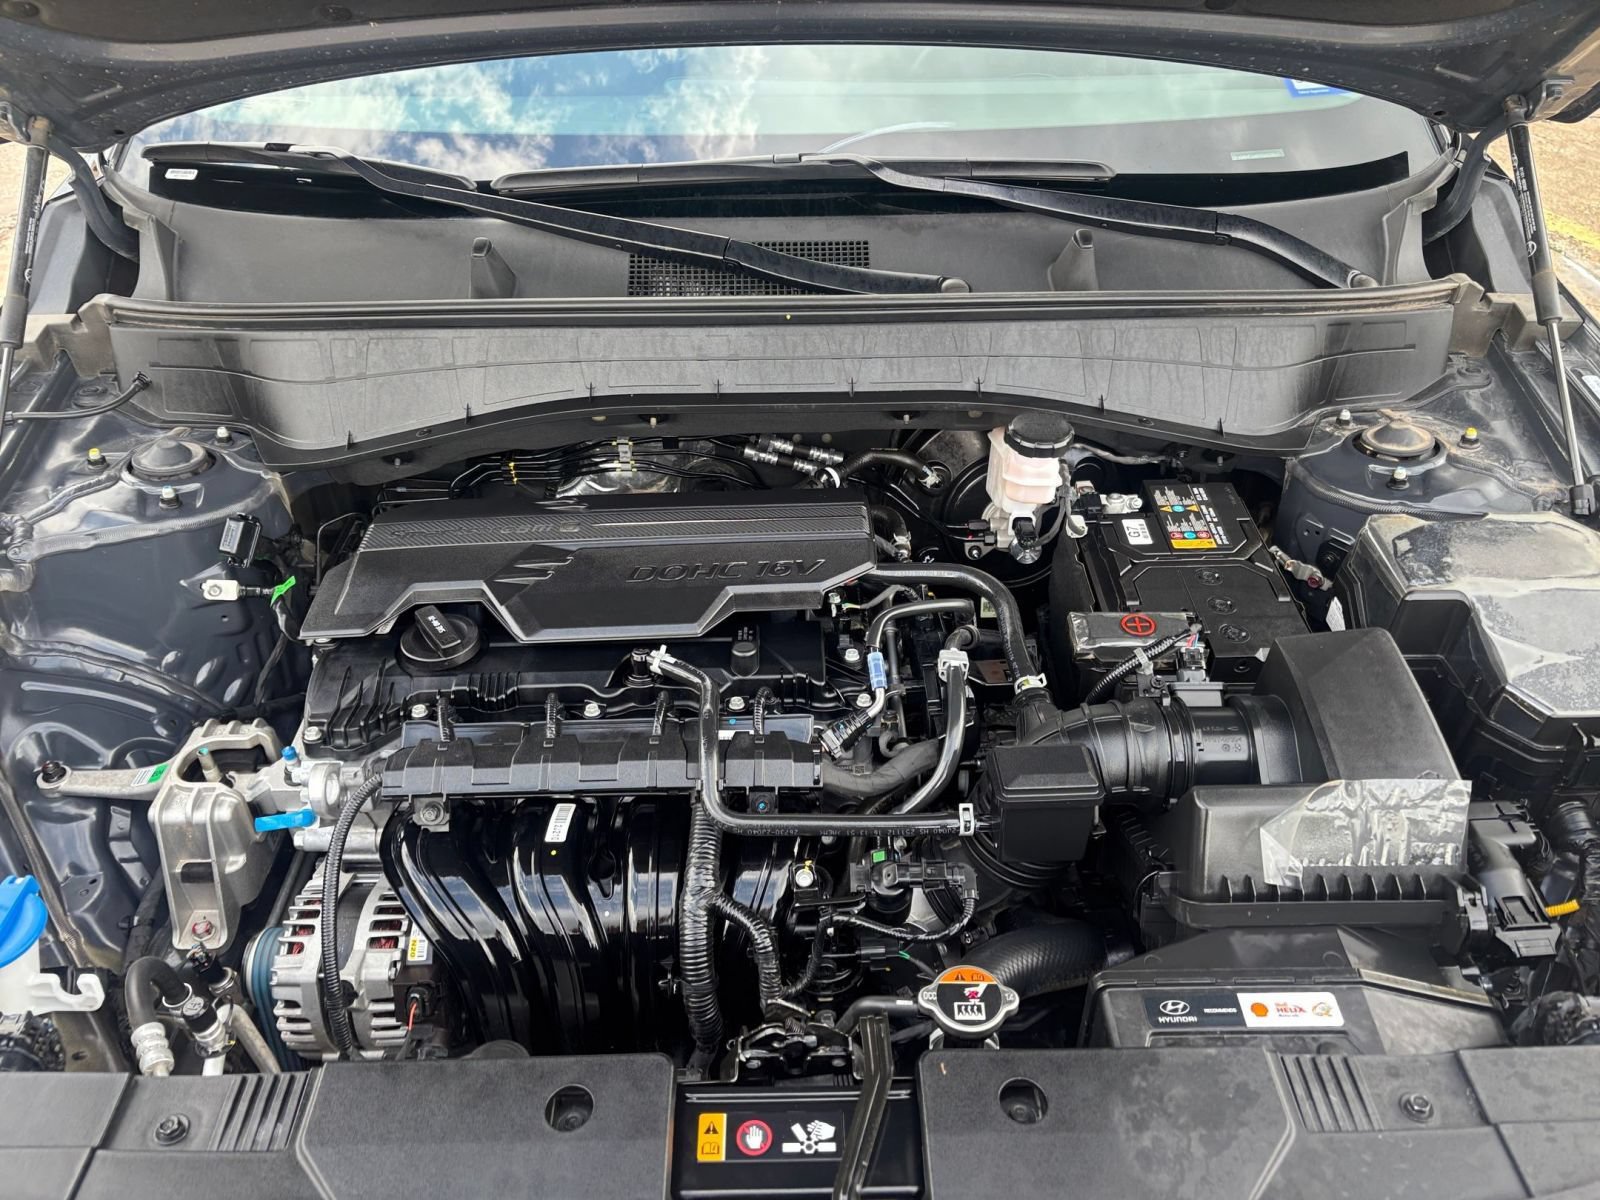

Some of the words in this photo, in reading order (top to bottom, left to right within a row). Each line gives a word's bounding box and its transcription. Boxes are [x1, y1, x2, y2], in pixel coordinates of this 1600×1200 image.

[1128, 526, 1141, 538] G7
[626, 560, 747, 584] DOHC
[755, 558, 826, 578] 16V
[1276, 1005, 1307, 1014] HELIX
[1157, 1015, 1198, 1024] HYUNDAI
